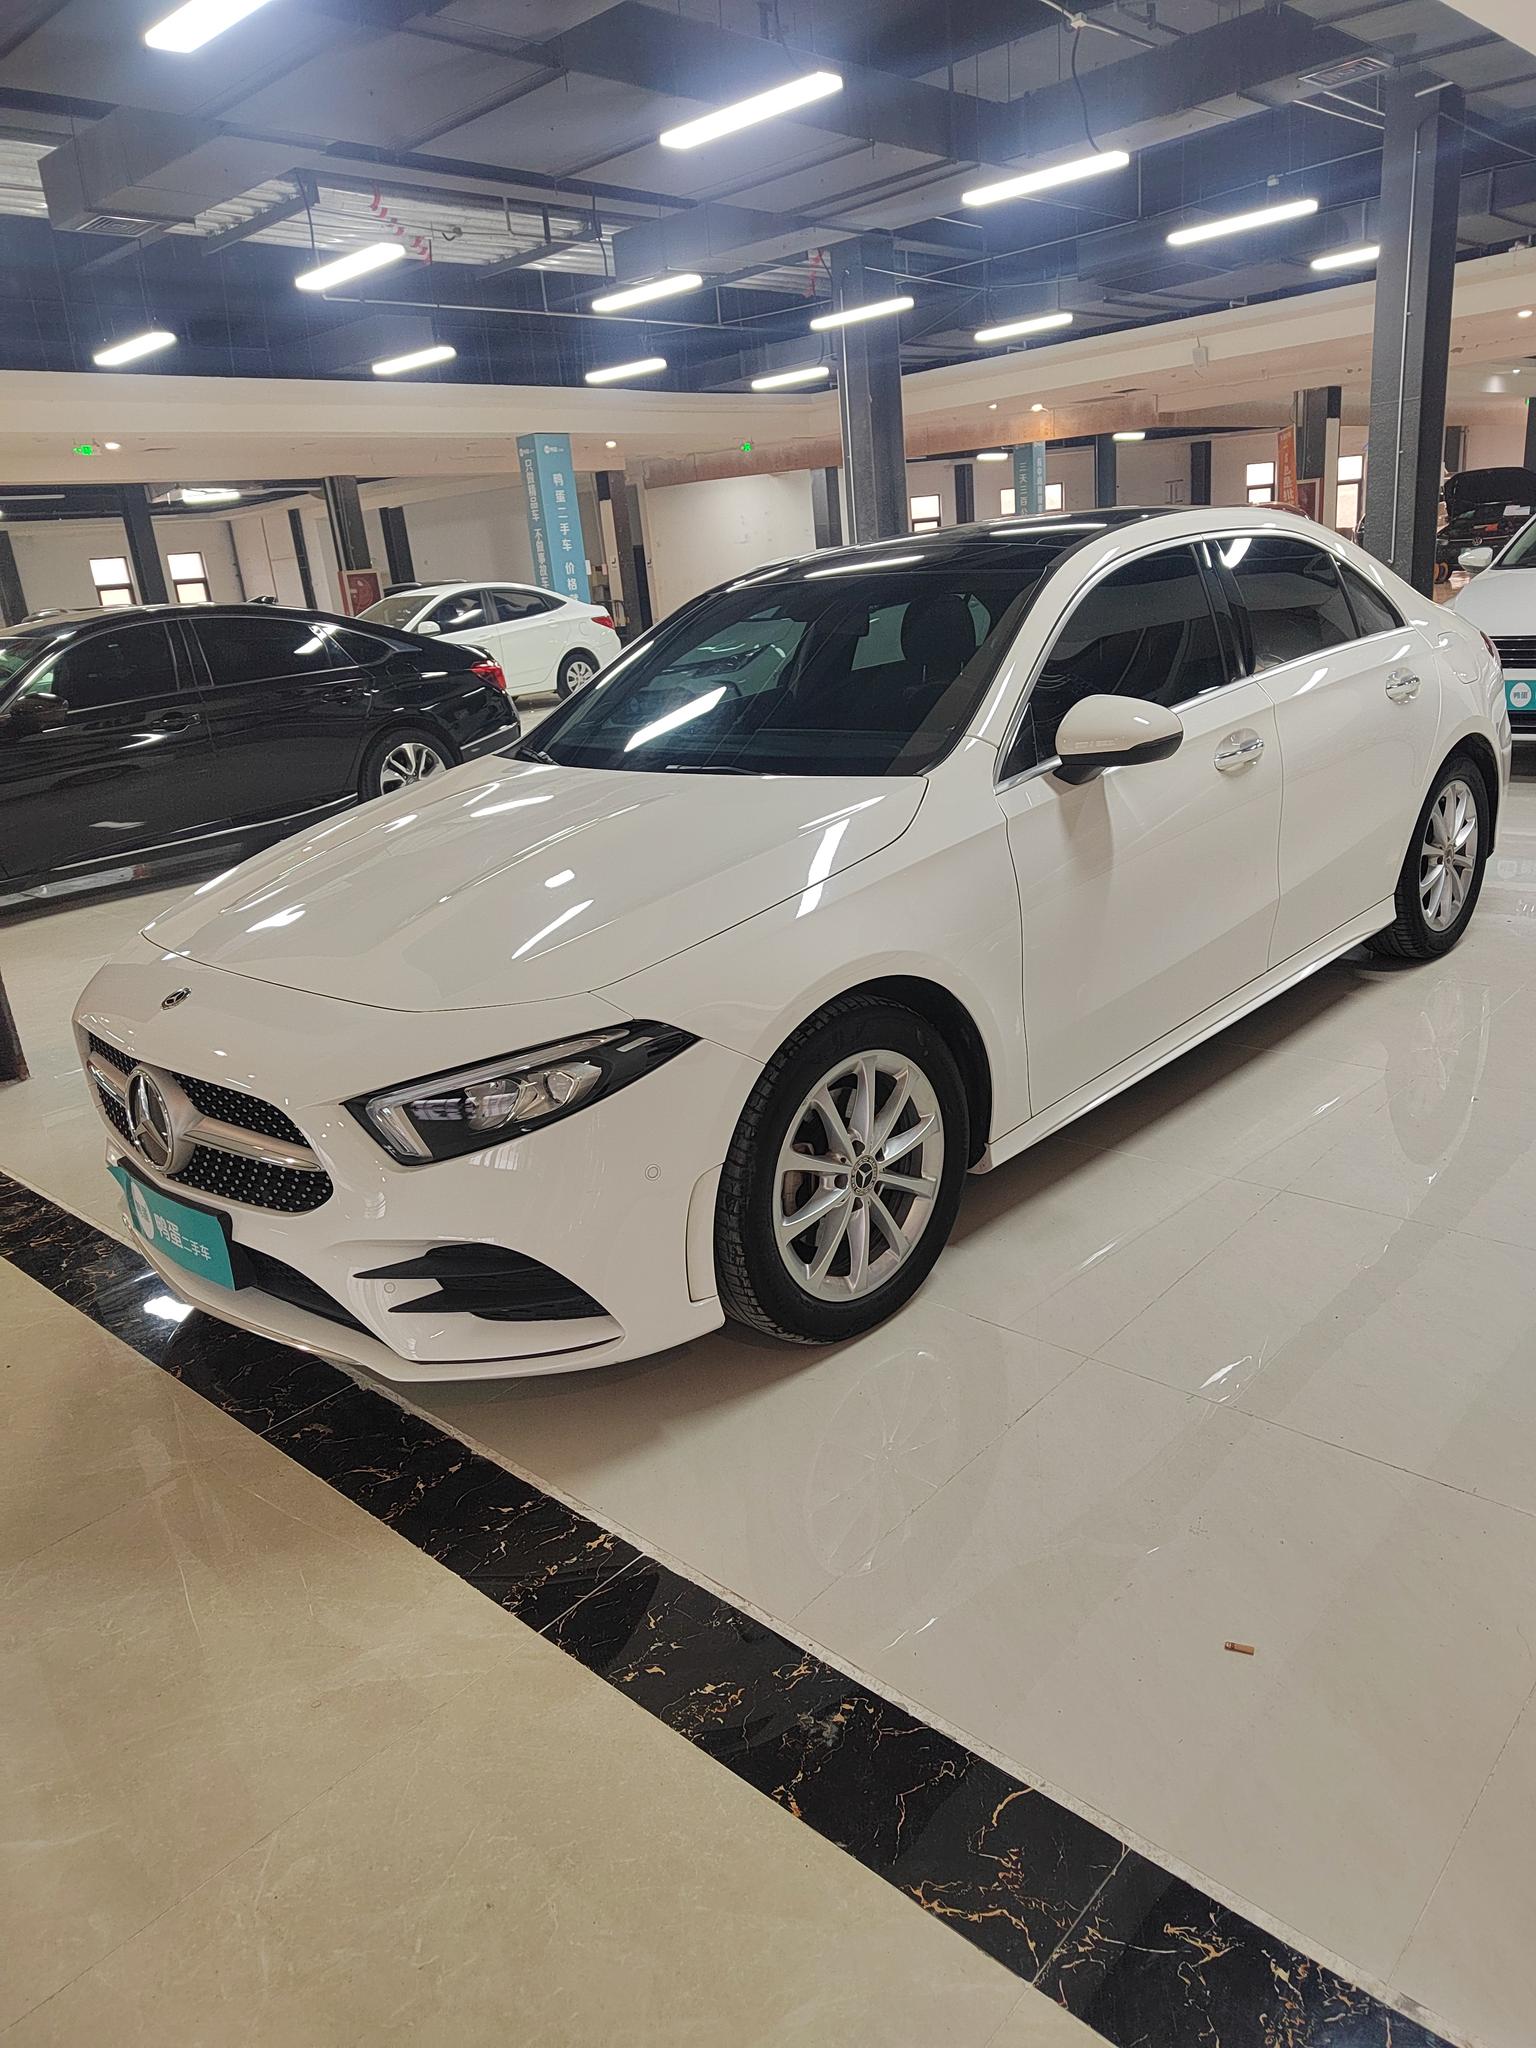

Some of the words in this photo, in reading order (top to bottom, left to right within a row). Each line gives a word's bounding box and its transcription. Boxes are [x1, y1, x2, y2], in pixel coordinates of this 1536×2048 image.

[553, 473, 572, 551] 鸭蛋二手车
[153, 1213, 211, 1260] 鸭蛋二手车
